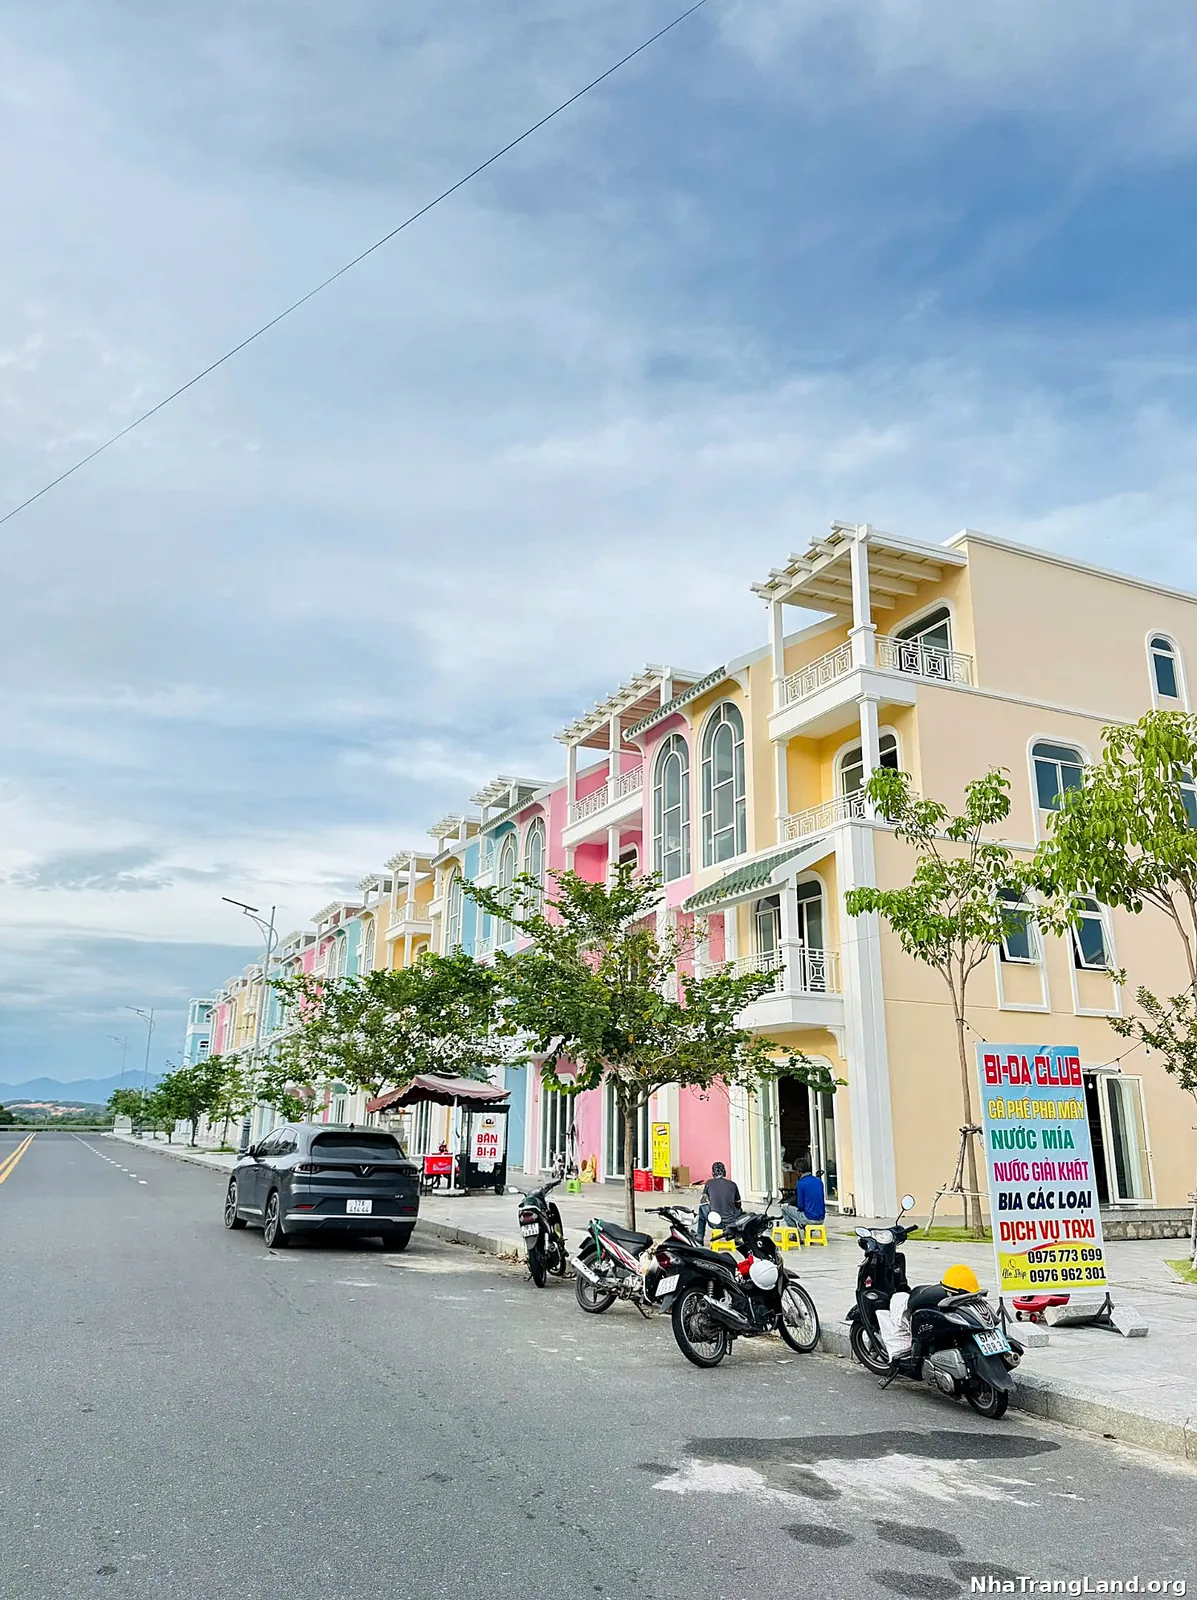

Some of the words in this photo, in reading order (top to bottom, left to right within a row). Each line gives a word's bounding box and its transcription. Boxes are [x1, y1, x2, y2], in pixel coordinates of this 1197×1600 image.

[984, 1054, 1032, 1086] BI-DA
[1034, 1055, 1083, 1087] CLUB
[988, 1096, 1005, 1119] CÀ
[1007, 1096, 1031, 1119] PHÊ
[1032, 1099, 1056, 1119] PHA
[1057, 1097, 1085, 1119] MÁY
[991, 1125, 1037, 1150] NƯỚC
[1042, 1126, 1074, 1150] MÍA
[994, 1158, 1030, 1182] NƯỚC
[1032, 1157, 1057, 1182] GIẢI
[1058, 1158, 1089, 1182] KHÁT
[998, 1191, 1023, 1211] BIA
[1027, 1187, 1055, 1210] CÁC
[1059, 1190, 1092, 1214] LOẠI
[1000, 1221, 1037, 1246] DỊCH
[1039, 1220, 1061, 1243] VỤ
[1062, 1219, 1096, 1239] TAXI
[1027, 1250, 1056, 1264] 0975
[1058, 1249, 1078, 1262] 773
[1081, 1248, 1103, 1261] 699
[1029, 1269, 1059, 1283] 0976
[1061, 1267, 1084, 1281] 962
[1085, 1267, 1107, 1280] 301
